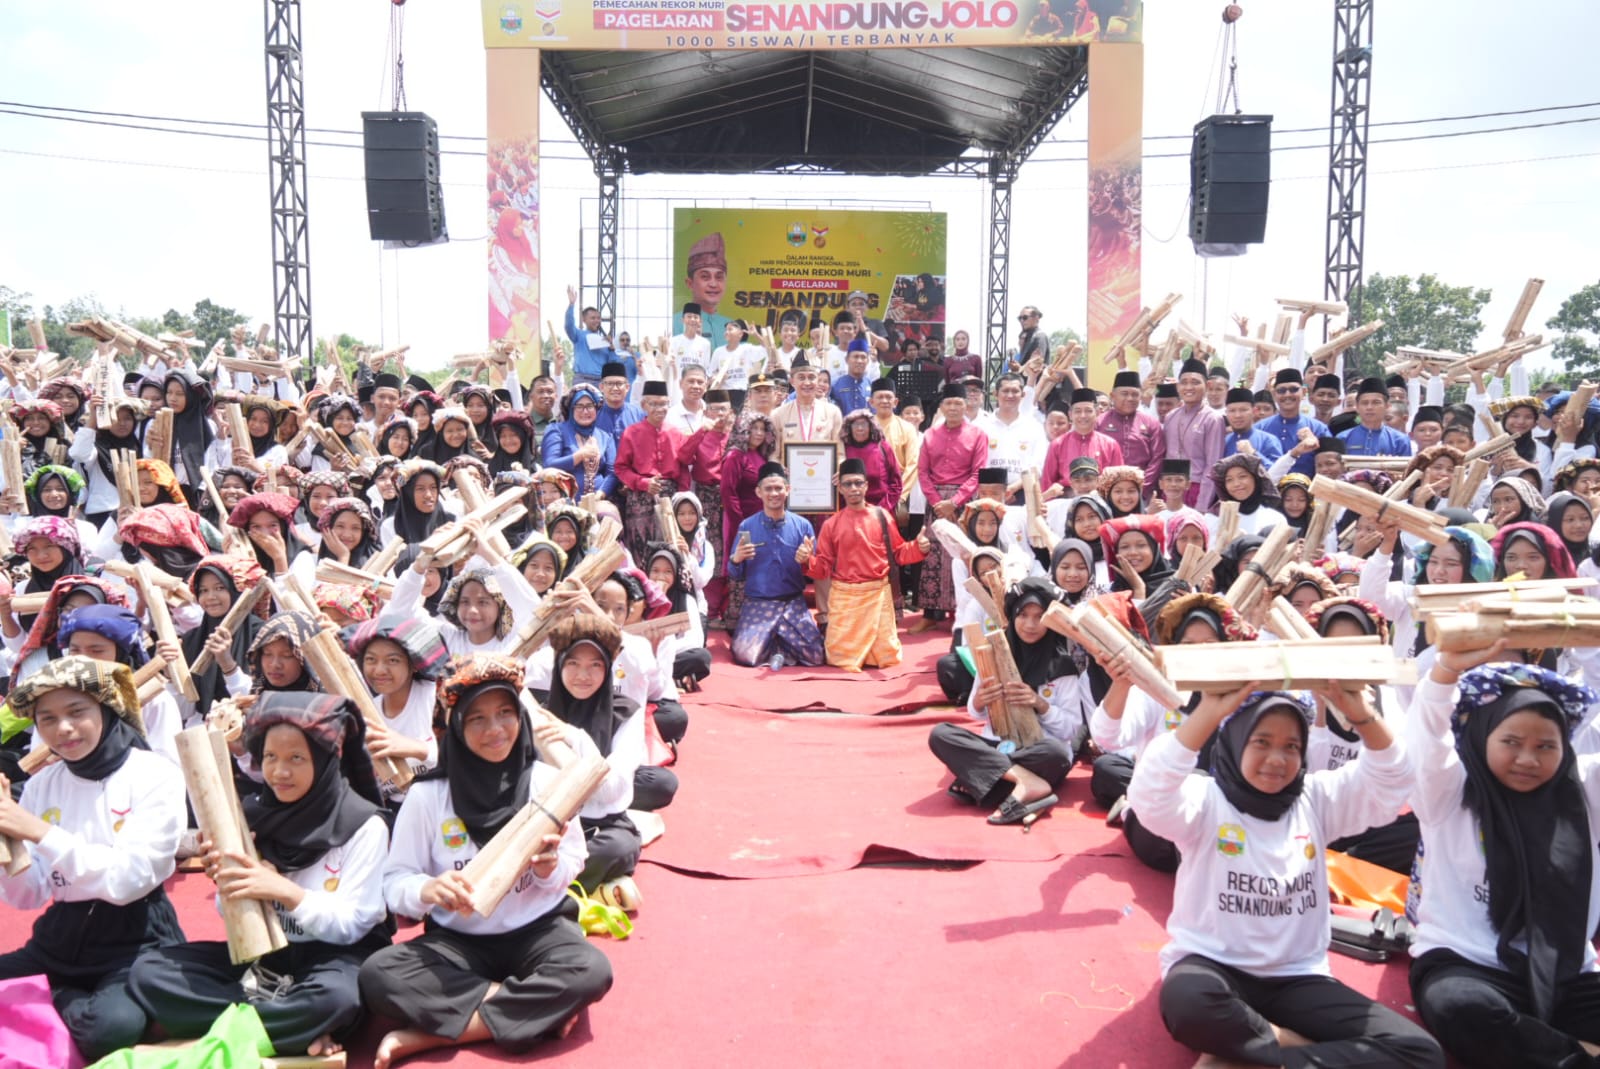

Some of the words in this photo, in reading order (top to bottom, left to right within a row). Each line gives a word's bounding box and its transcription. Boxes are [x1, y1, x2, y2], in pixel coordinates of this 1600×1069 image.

[593, 0, 658, 9] PEMECAHAN
[661, 0, 696, 9] REKOR
[699, 0, 725, 9] MURI
[604, 13, 713, 28] PAGELARAN
[666, 36, 713, 47] 1000
[727, 34, 814, 48] SISWA/I
[827, 33, 954, 46] TERBANYAK
[749, 268, 809, 276] PEMECAHAN
[812, 269, 843, 277] REKOR
[846, 269, 871, 277] MURI
[782, 280, 838, 288] PAGELARAN
[734, 291, 879, 309] SENANDUG
[1227, 871, 1279, 896] REKOR
[1285, 871, 1316, 896] MUR
[1218, 893, 1292, 917] SENANDUNG
